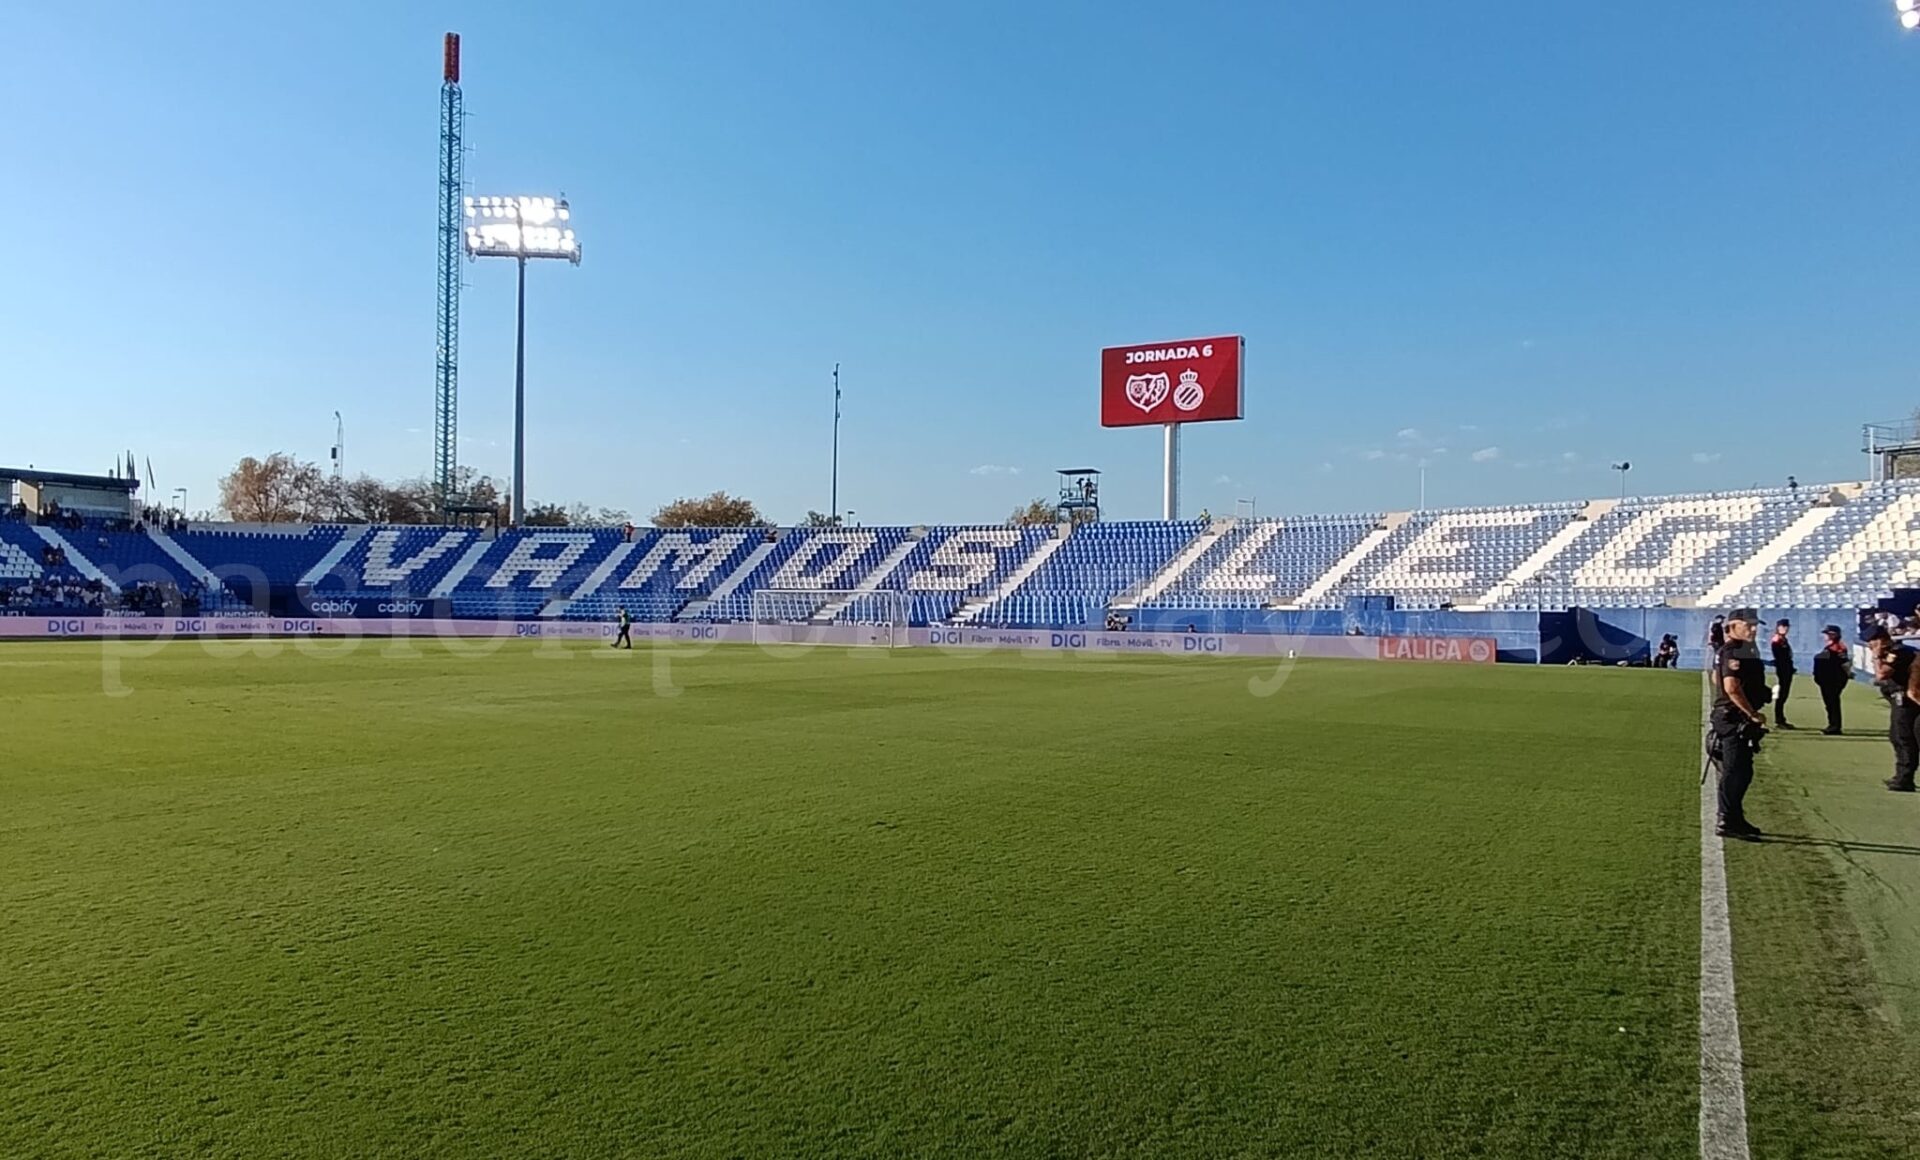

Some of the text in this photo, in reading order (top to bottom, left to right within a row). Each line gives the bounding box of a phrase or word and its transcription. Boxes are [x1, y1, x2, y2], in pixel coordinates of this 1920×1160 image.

[1125, 344, 1213, 364] JORNADA 6
[311, 599, 358, 615] cabify
[377, 600, 424, 616] cabify
[47, 619, 85, 633] DIGI
[175, 620, 206, 632] DIGI
[283, 620, 316, 632] DIGI
[691, 626, 719, 639] DIGI
[930, 631, 963, 644] DIGI
[1028, 636, 1040, 644] TV
[1051, 633, 1087, 648] DIGI
[1127, 637, 1153, 647] Móvil
[1160, 639, 1173, 648] TV
[1183, 636, 1223, 651] DIGI
[1383, 638, 1462, 661] LALIGA
